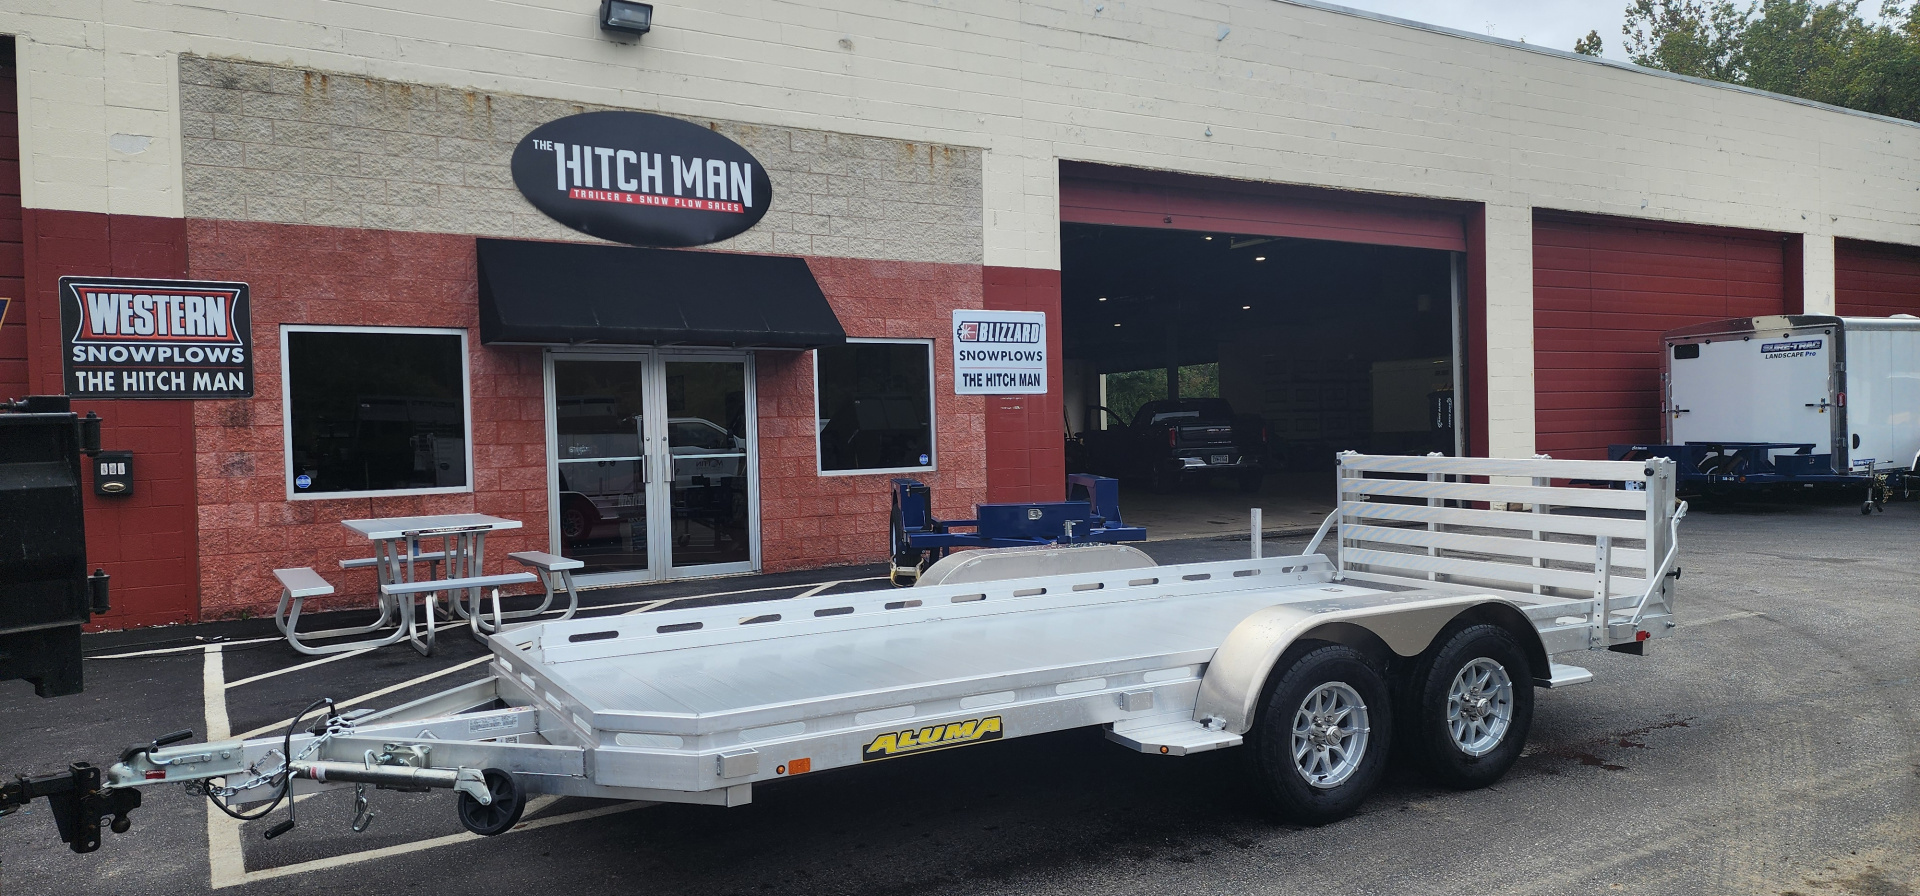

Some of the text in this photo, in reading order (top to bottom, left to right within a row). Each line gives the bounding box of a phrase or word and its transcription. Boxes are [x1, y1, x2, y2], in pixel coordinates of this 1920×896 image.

[533, 139, 553, 151] THE
[554, 142, 752, 207] HITCH MAN
[574, 189, 739, 212] TRAILER & SNOW PLOW SALES
[86, 292, 227, 337] WESTERN
[978, 322, 1040, 343] BLIZZARD
[72, 345, 245, 363] SNOWPLOWS
[959, 350, 1043, 361] SNOWPLOWS
[1762, 340, 1821, 352] SURE-TRAC
[1765, 351, 1804, 359] LANDSCAPE
[75, 371, 244, 392] THE HITCH MAN
[962, 373, 1040, 387] THE HITCH MAN
[866, 717, 1001, 754] ALUMA
